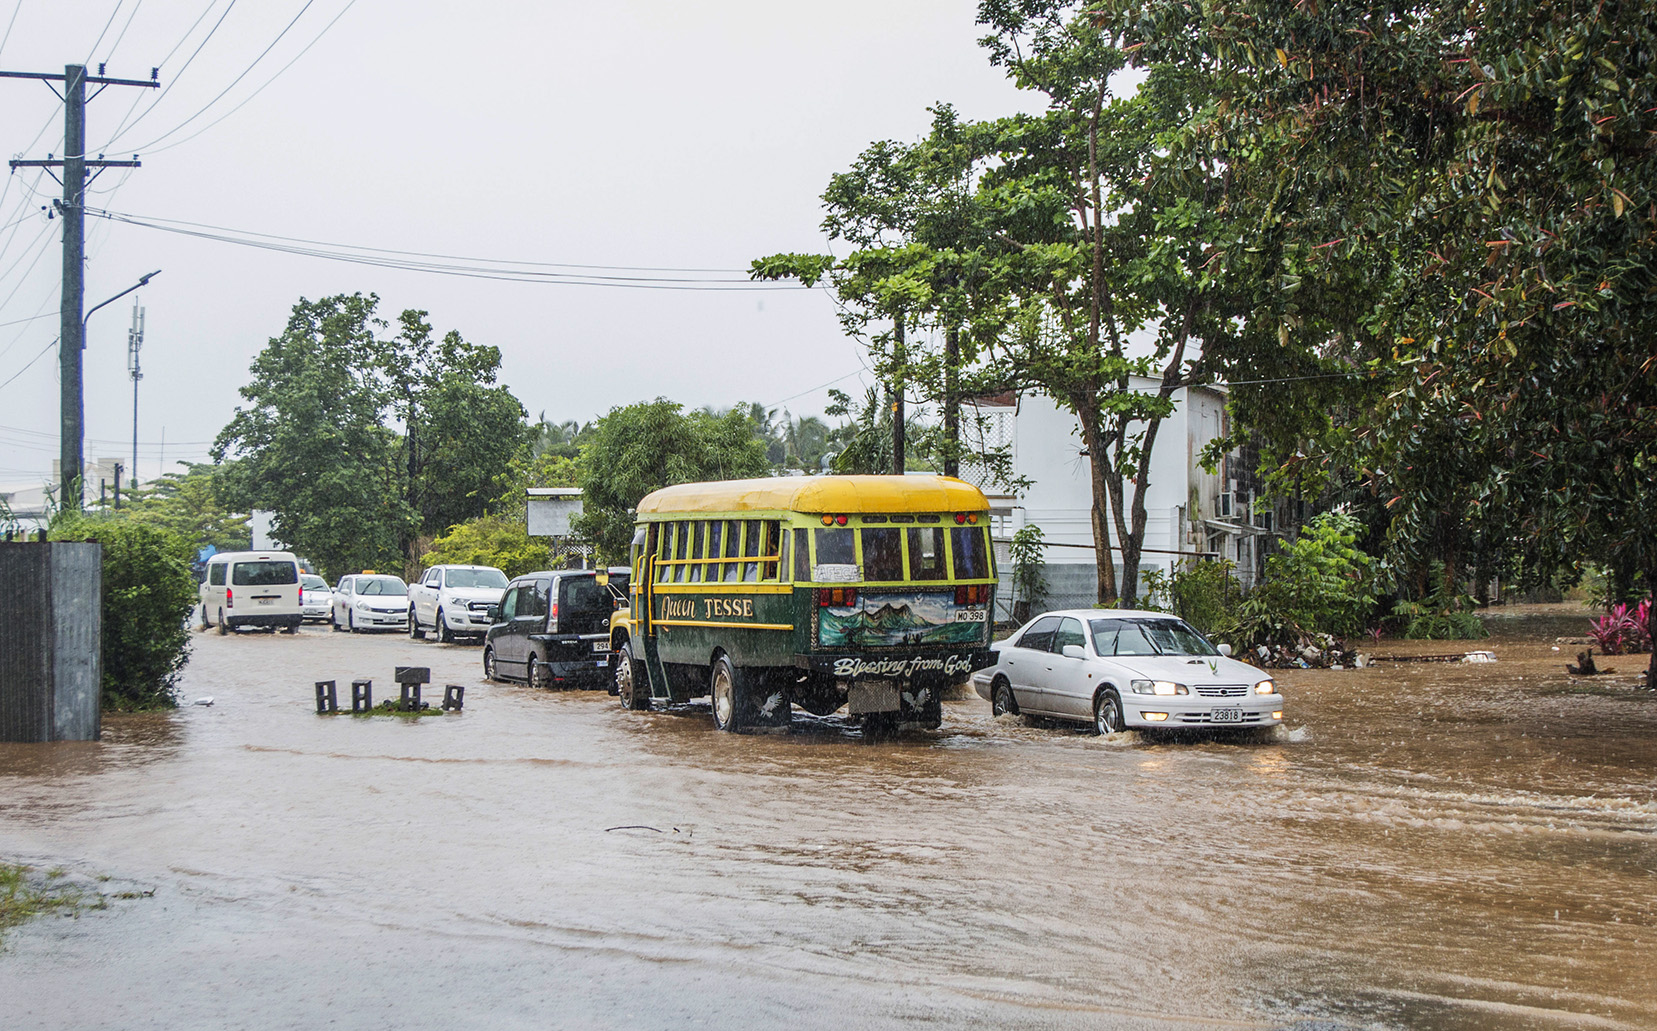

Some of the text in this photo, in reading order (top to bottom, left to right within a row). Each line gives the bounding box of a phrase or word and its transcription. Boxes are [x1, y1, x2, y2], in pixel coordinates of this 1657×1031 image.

[661, 595, 754, 631] Queen JESSE
[969, 612, 984, 621] 398
[833, 653, 972, 677] Blessing from God
[1214, 711, 1239, 720] 23818
